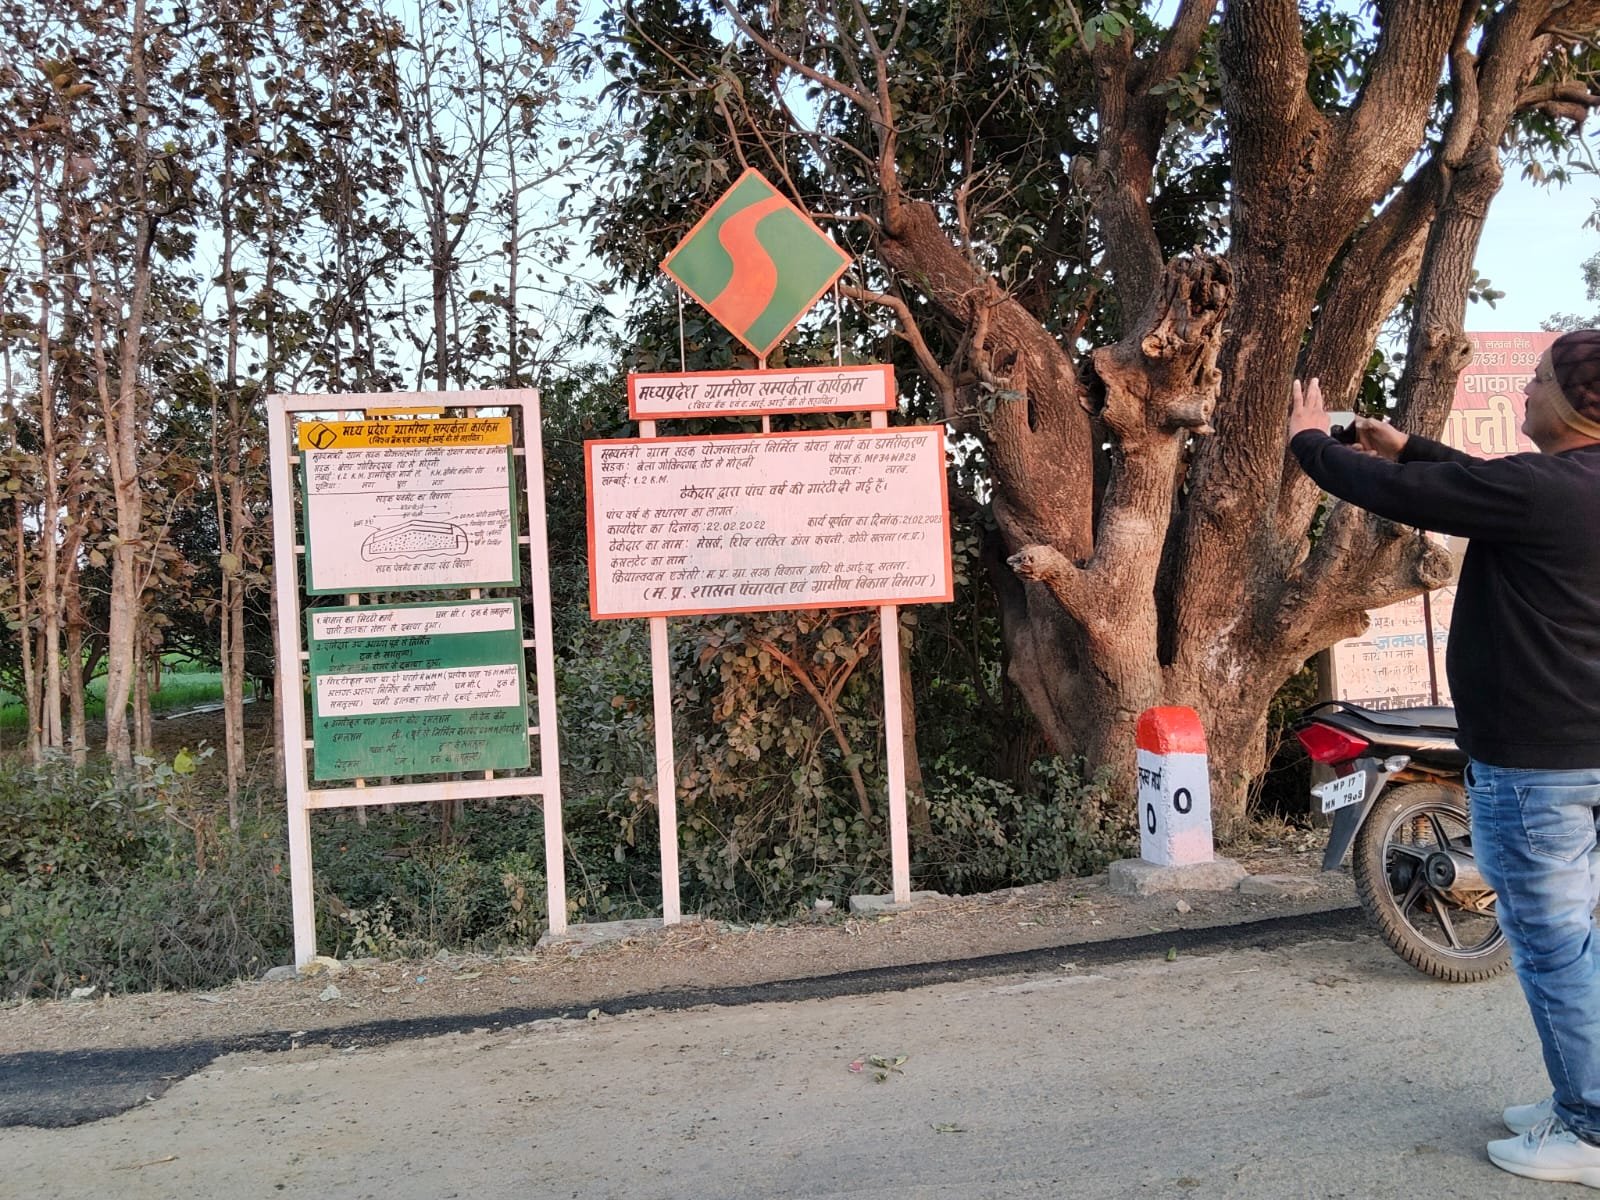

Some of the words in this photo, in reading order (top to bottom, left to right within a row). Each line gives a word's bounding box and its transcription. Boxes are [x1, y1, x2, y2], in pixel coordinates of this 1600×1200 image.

[639, 382, 698, 402] मध्यप्रदेश
[705, 379, 755, 399] ग्रामीण
[759, 376, 815, 396] सम्पर्कता
[817, 374, 868, 395] कार्यक्रम
[343, 425, 364, 436] मध्य
[367, 423, 389, 436] प्रदेश
[394, 423, 431, 434] ग्रामीण
[433, 422, 469, 434] सम्पर्कता
[471, 420, 500, 433] कार्यक्रम
[647, 447, 669, 458] ग्राम
[765, 439, 798, 453] निर्मित
[834, 437, 855, 450] मार्ग
[857, 439, 872, 449] का
[715, 458, 724, 468] से
[680, 484, 714, 499] ठेकेदार
[745, 484, 766, 497] पांच
[769, 480, 788, 495] वर्ष
[789, 481, 805, 495] की
[807, 480, 836, 493] गारंटी
[837, 479, 851, 494] दी
[855, 477, 874, 494] गई
[625, 507, 641, 519] वर्ष
[691, 507, 705, 517] का
[650, 524, 665, 533] का
[807, 513, 827, 527] कार्य
[828, 514, 852, 528] पूर्णता
[856, 517, 869, 526] का
[609, 538, 644, 552] ठेकेदार
[645, 540, 658, 550] का
[651, 556, 664, 566] का
[612, 570, 665, 583] क्रियान्वयन
[775, 564, 806, 576] विकास
[691, 584, 735, 597] शासन
[738, 579, 786, 597] पंचायत
[789, 578, 808, 593] एवं
[811, 575, 854, 594] ग्रामीण
[856, 574, 890, 590] विकास
[1333, 781, 1344, 792] MP
[1349, 777, 1356, 787] 17
[1174, 788, 1192, 814] 0
[1147, 803, 1156, 835] 0
